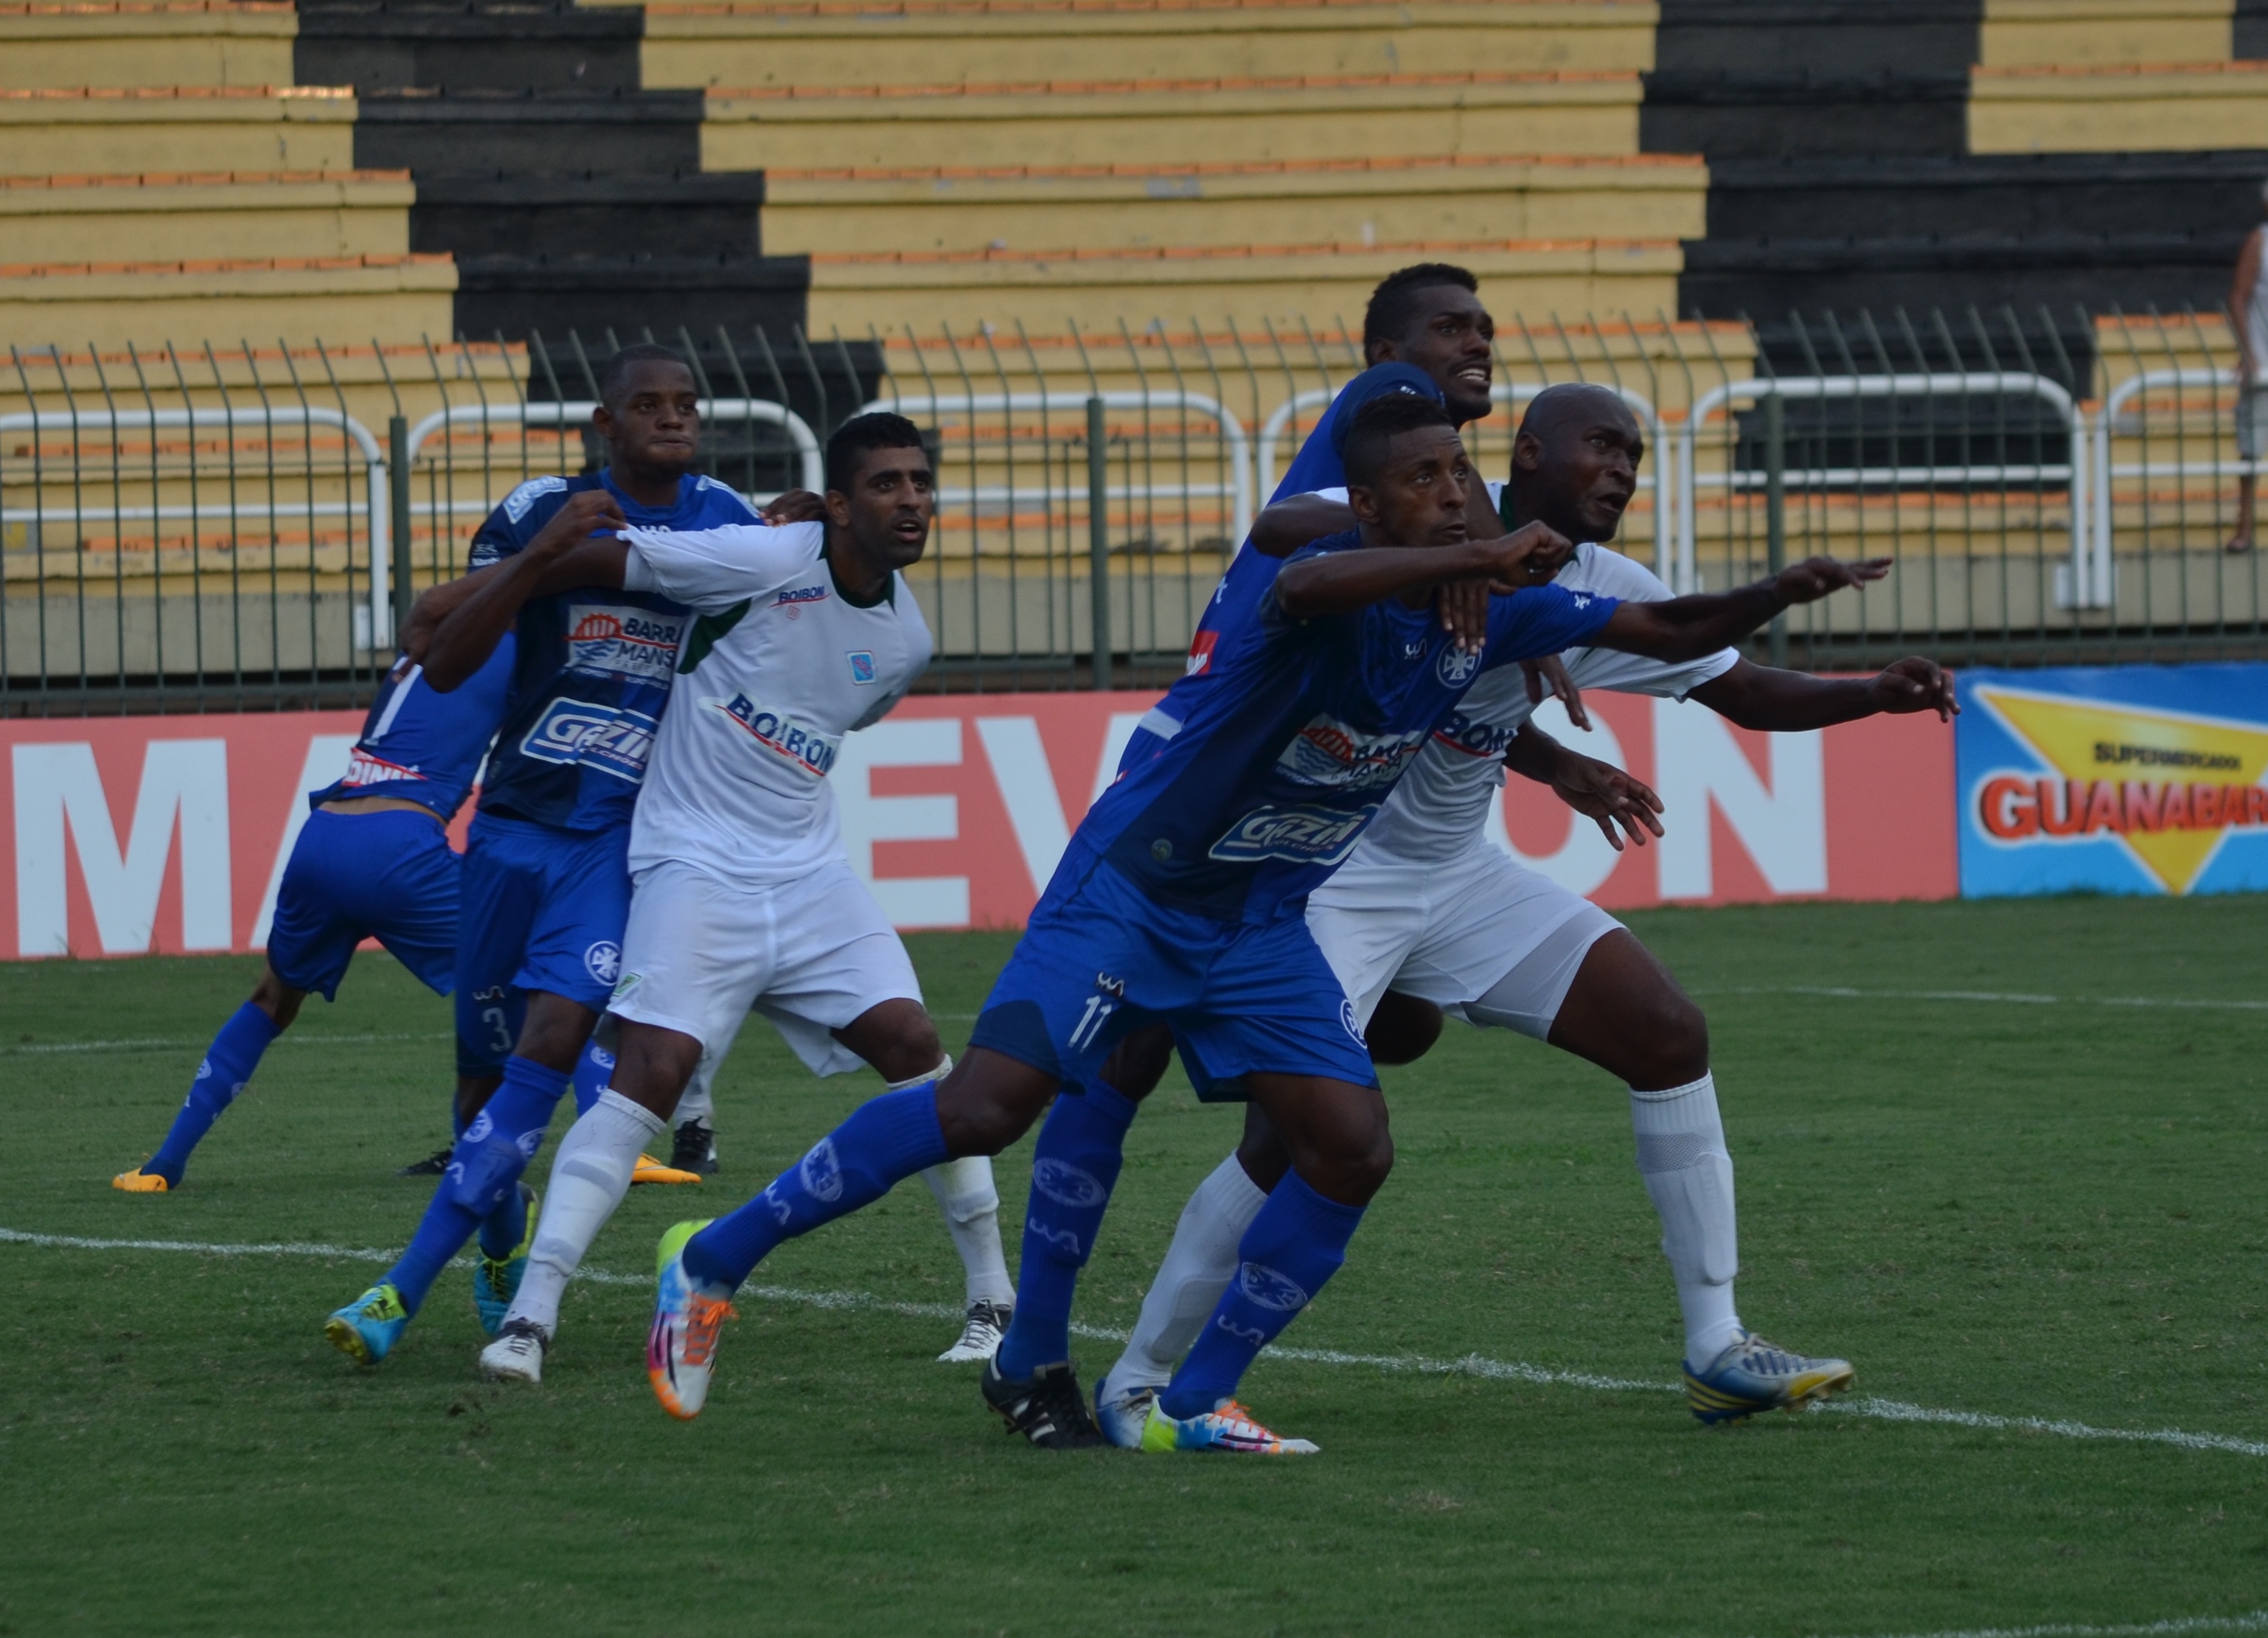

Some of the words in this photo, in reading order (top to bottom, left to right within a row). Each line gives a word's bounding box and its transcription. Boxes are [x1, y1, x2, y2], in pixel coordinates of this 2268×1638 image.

[779, 586, 825, 602] BOIBON
[727, 692, 835, 773] BOIBON
[1242, 812, 1368, 847] GAZIN
[481, 1007, 514, 1053] 3
[1067, 995, 1112, 1053] 11
